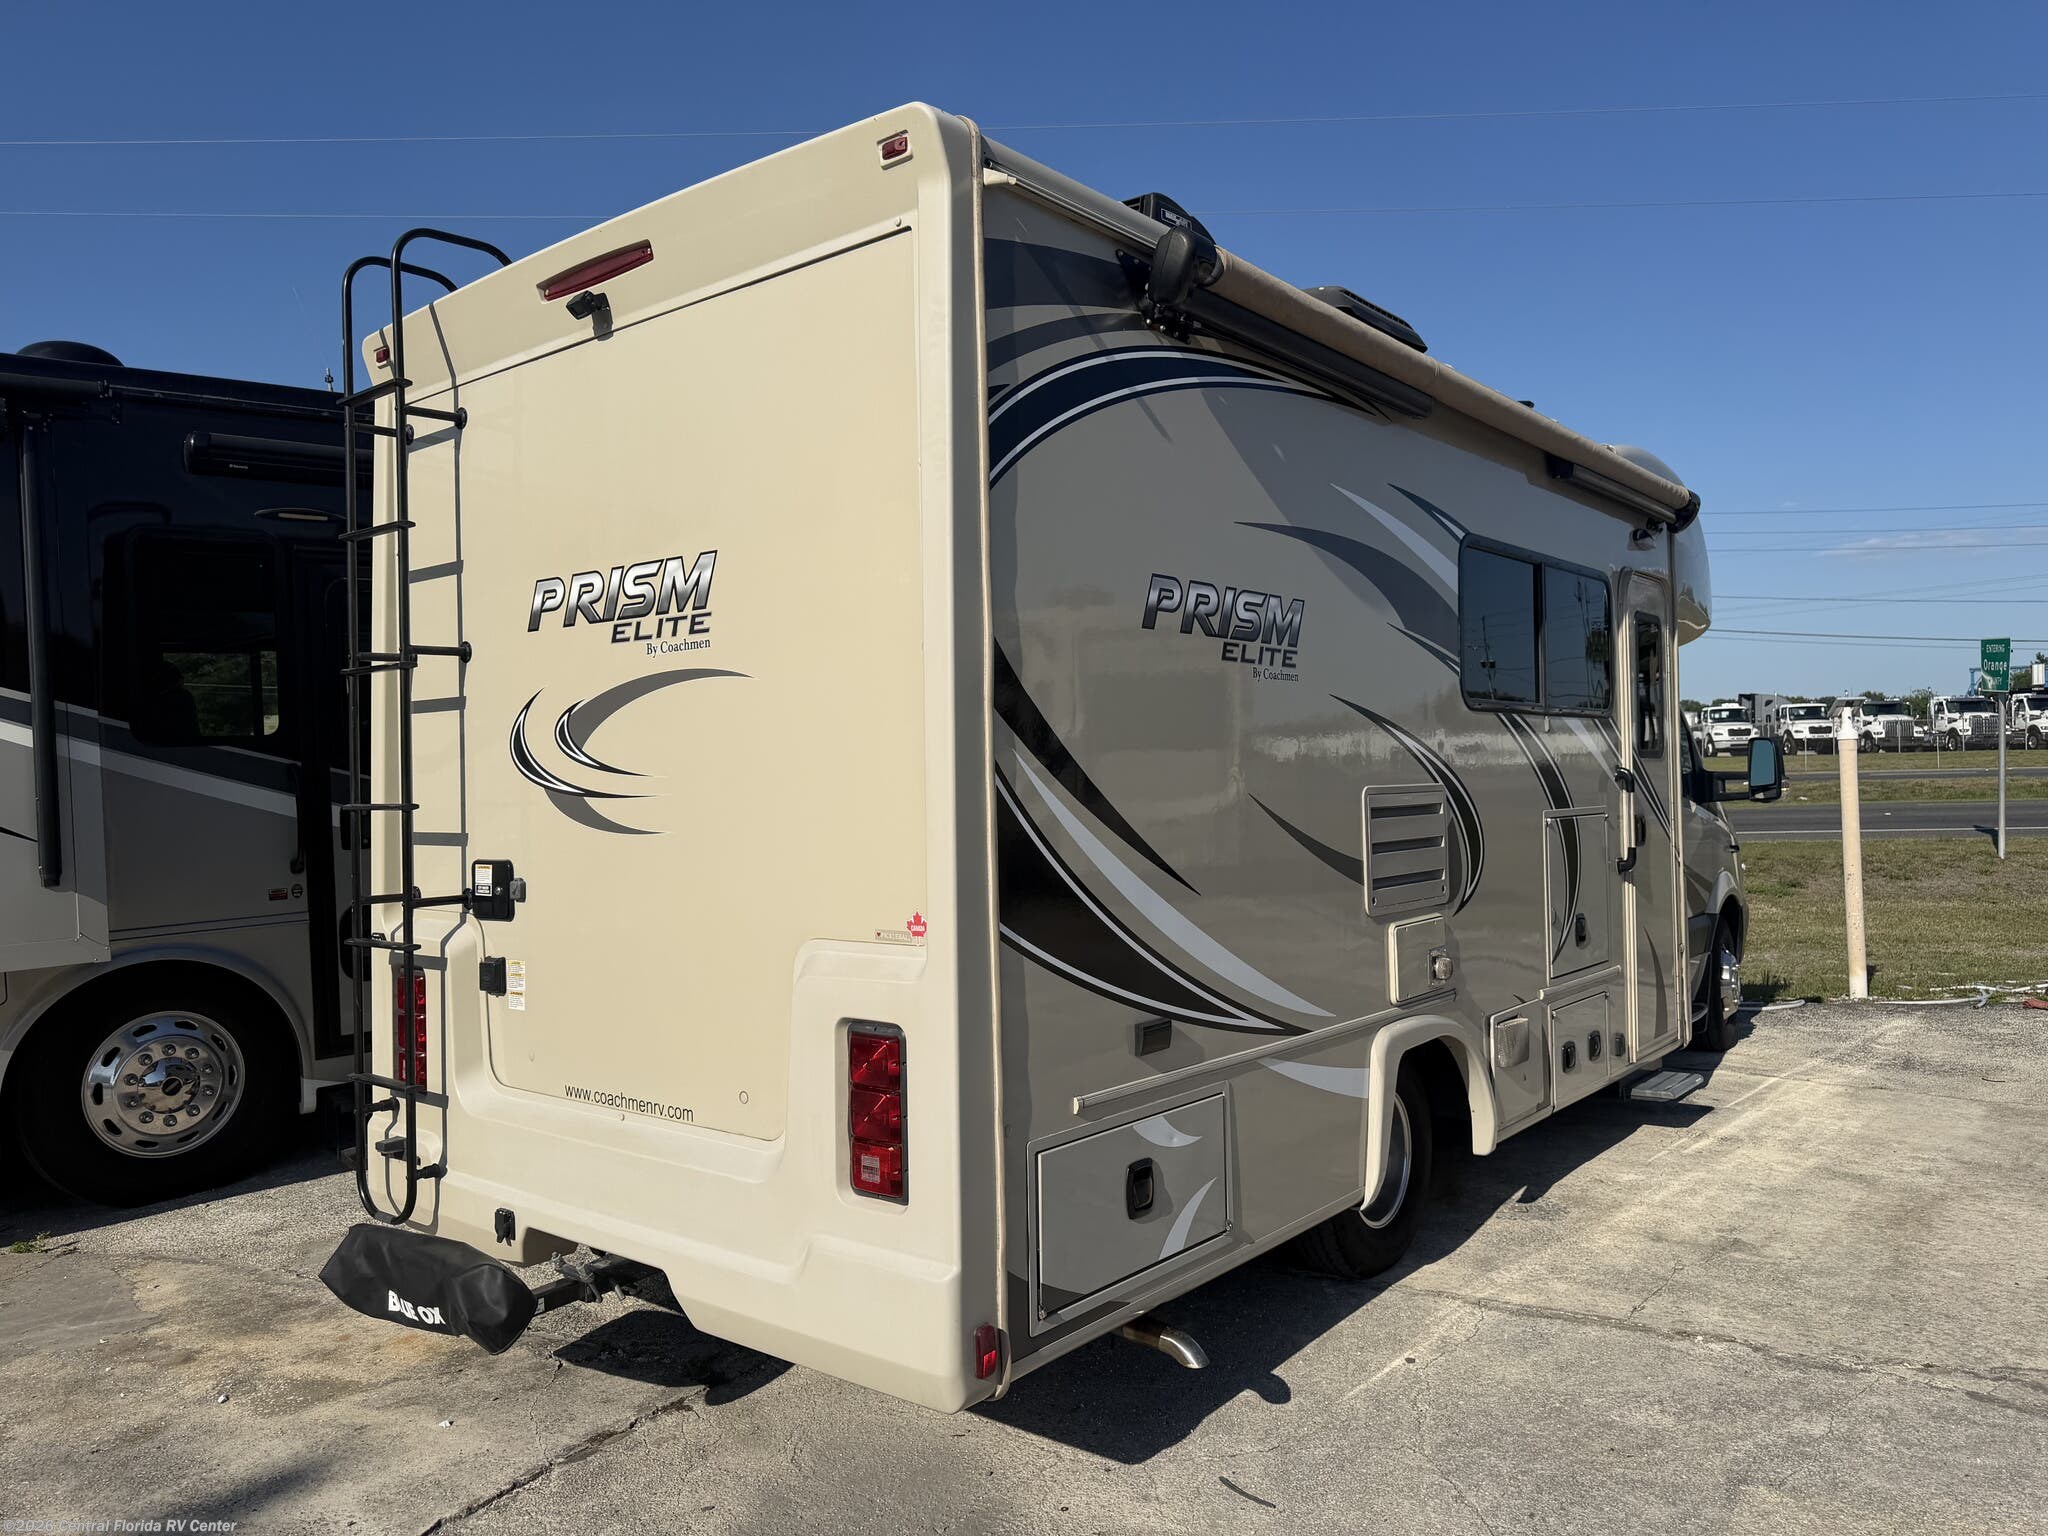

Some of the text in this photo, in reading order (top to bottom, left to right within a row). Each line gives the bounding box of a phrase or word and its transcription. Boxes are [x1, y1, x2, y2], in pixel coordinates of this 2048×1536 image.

[527, 550, 718, 632] PRISM
[1141, 573, 1305, 648] PRISM
[611, 612, 712, 644] ELITE
[646, 638, 711, 659] By Coachmen
[1221, 641, 1298, 668] ELITE
[1252, 666, 1299, 683] By Coachmen
[1983, 659, 2007, 673] Orange
[564, 1084, 694, 1123] www.coachmenrv.com
[388, 1289, 446, 1325] BLUE OX
